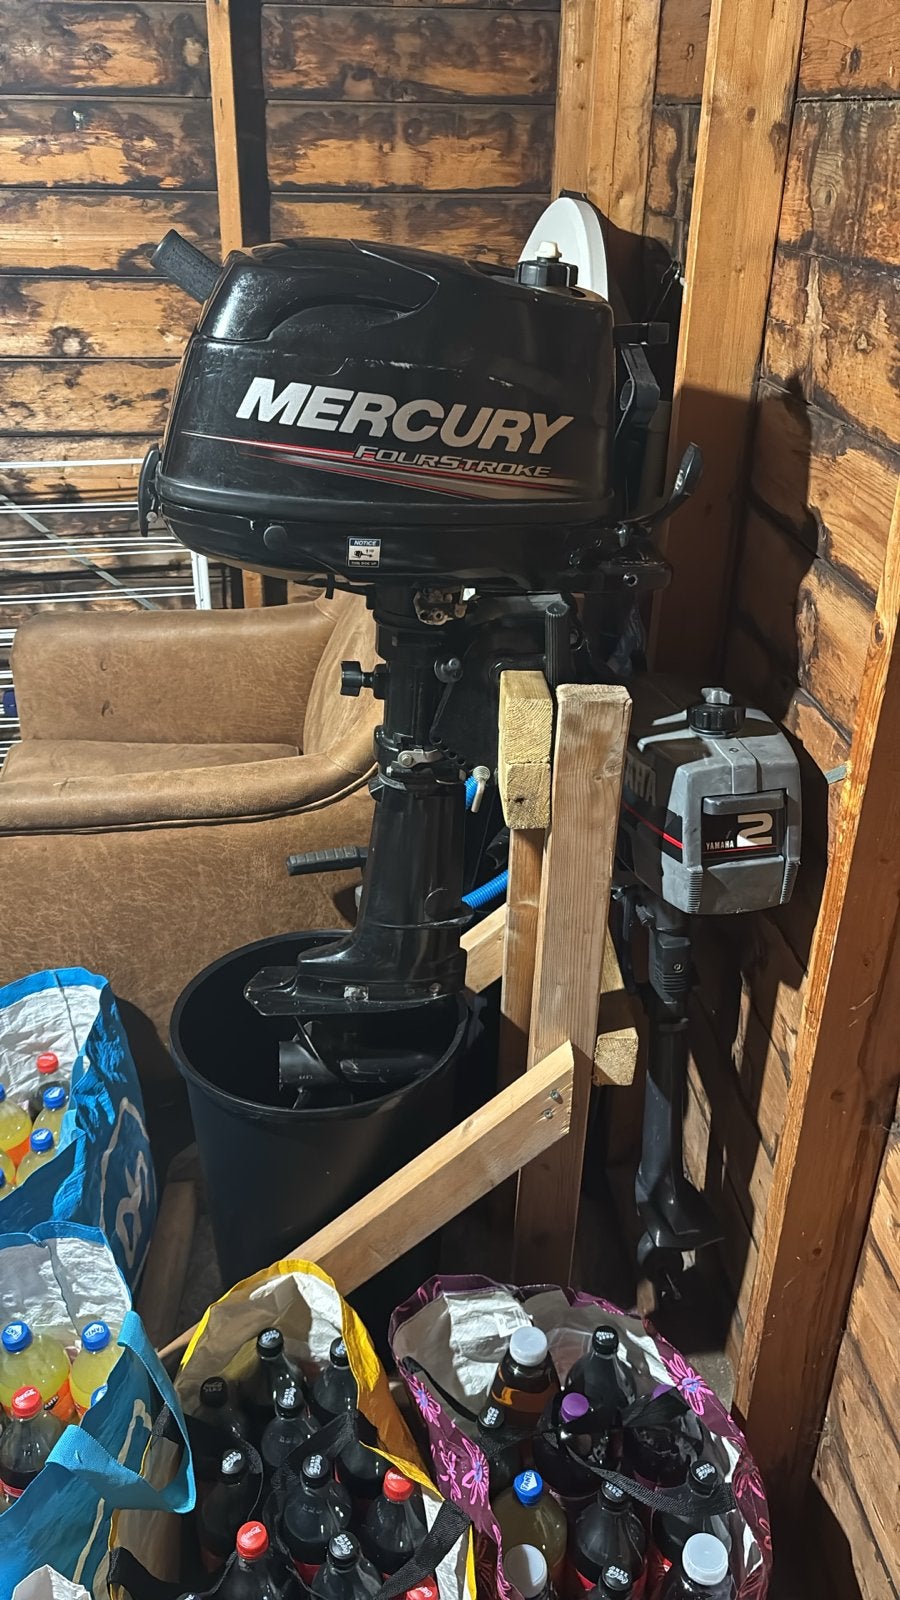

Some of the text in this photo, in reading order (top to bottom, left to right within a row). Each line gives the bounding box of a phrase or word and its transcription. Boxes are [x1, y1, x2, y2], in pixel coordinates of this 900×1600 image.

[235, 376, 575, 455] MERCURY
[354, 445, 552, 478] FOURSTROKE
[705, 812, 773, 850] YAMAHA 2
